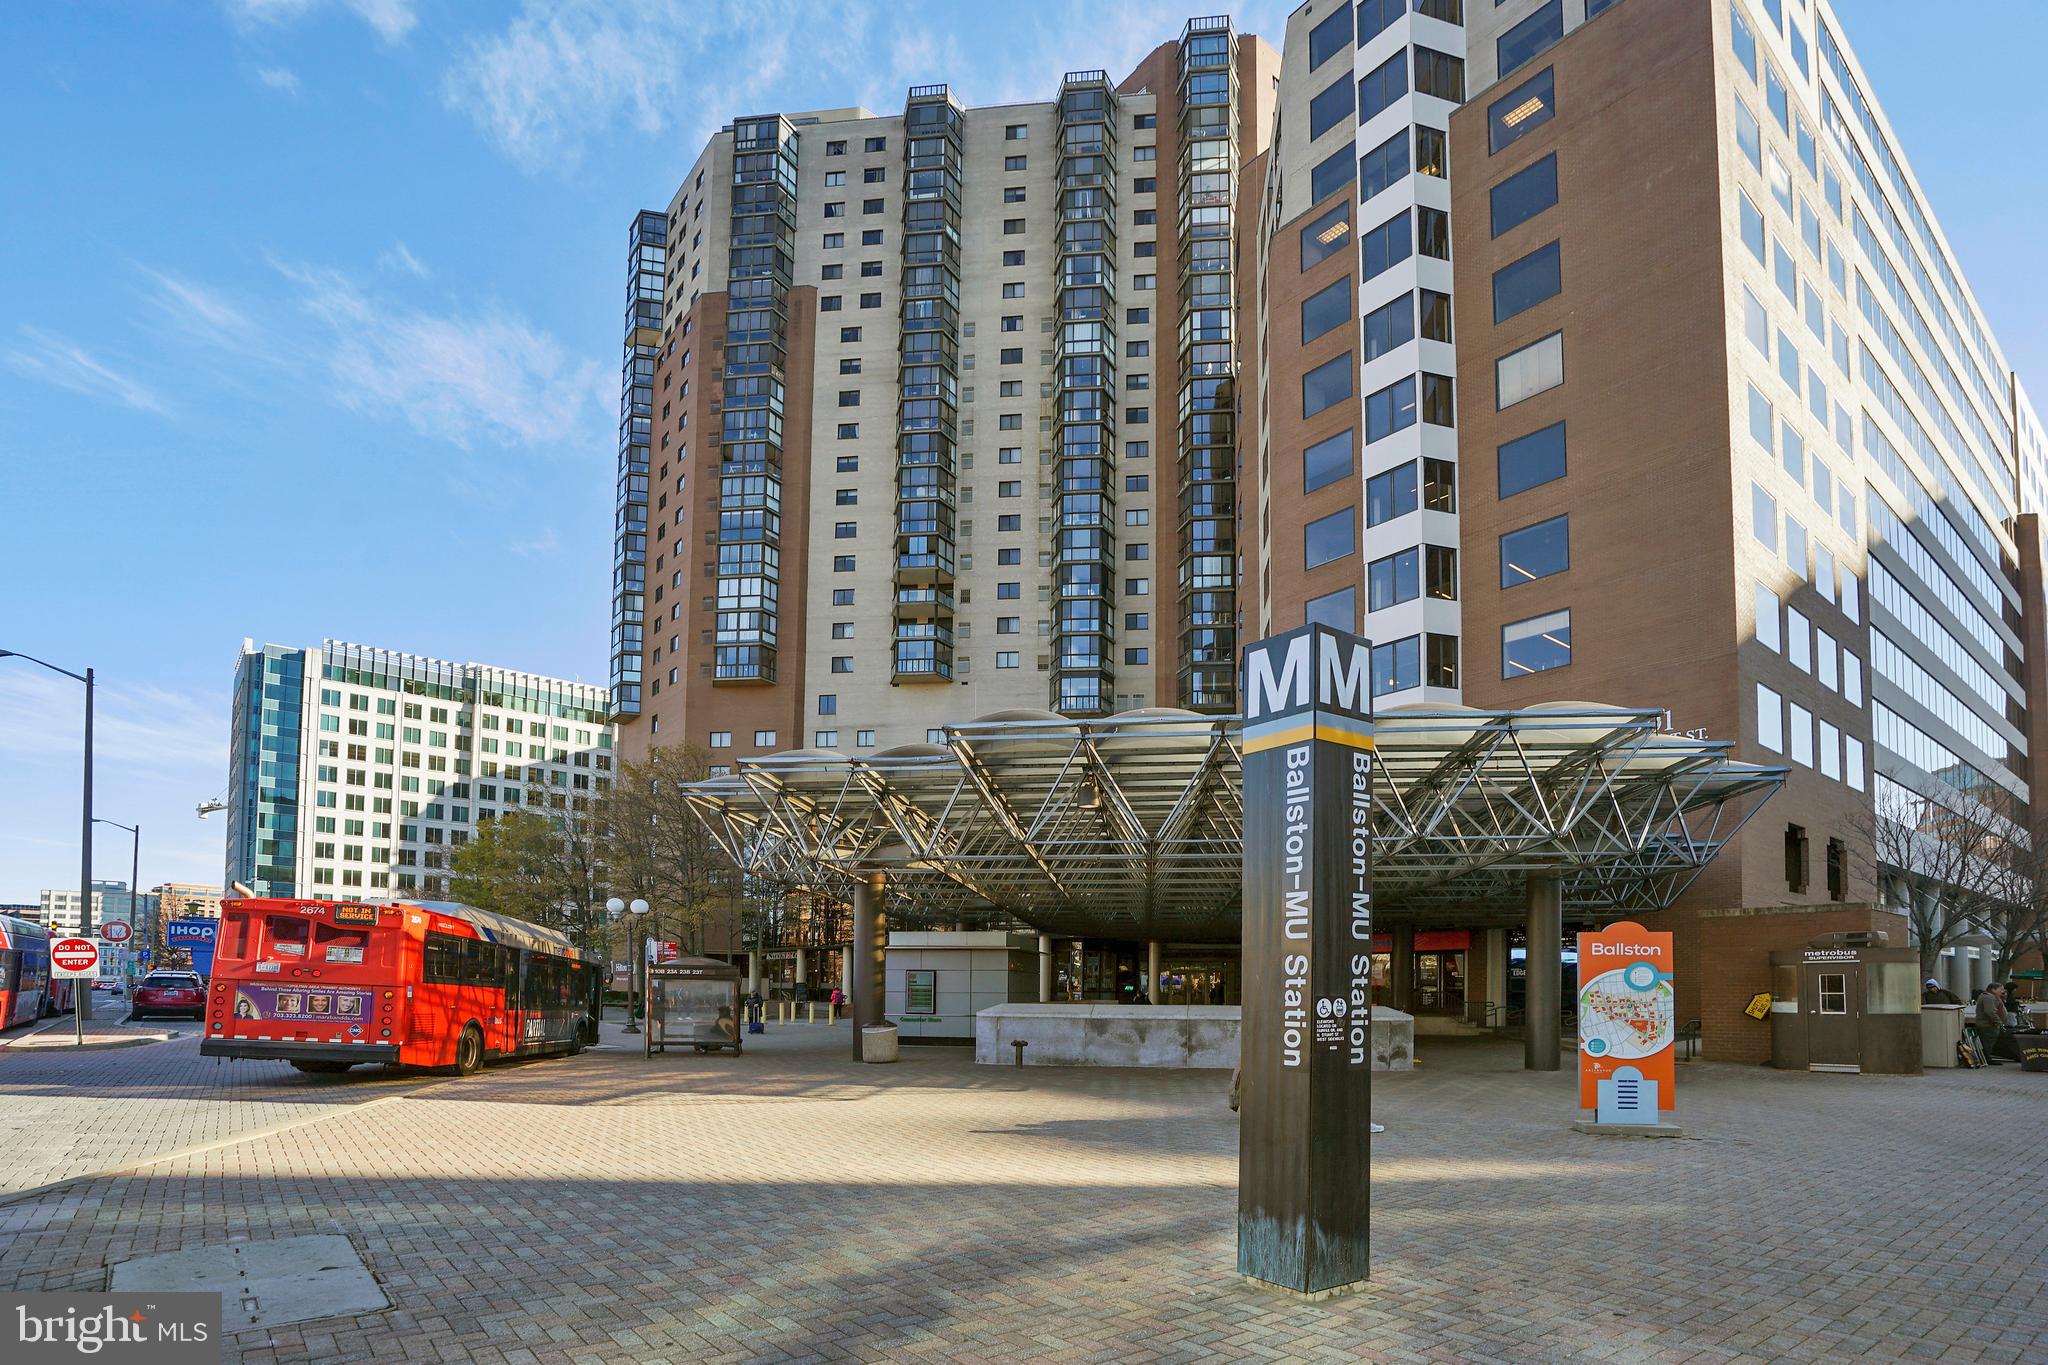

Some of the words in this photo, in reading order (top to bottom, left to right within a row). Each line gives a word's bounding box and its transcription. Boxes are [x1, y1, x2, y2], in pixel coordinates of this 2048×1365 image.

[1247, 633, 1311, 720] M
[1319, 631, 1371, 715] M
[1285, 745, 1310, 940] Ballston-MU
[1351, 751, 1371, 941] Ballston-MU
[300, 906, 326, 915] 2674
[339, 912, 374, 920] SERVICE
[1591, 942, 1662, 956] Ballston
[1804, 949, 1857, 957] metrobus
[1283, 954, 1308, 1067] Station
[1349, 954, 1370, 1065] Station
